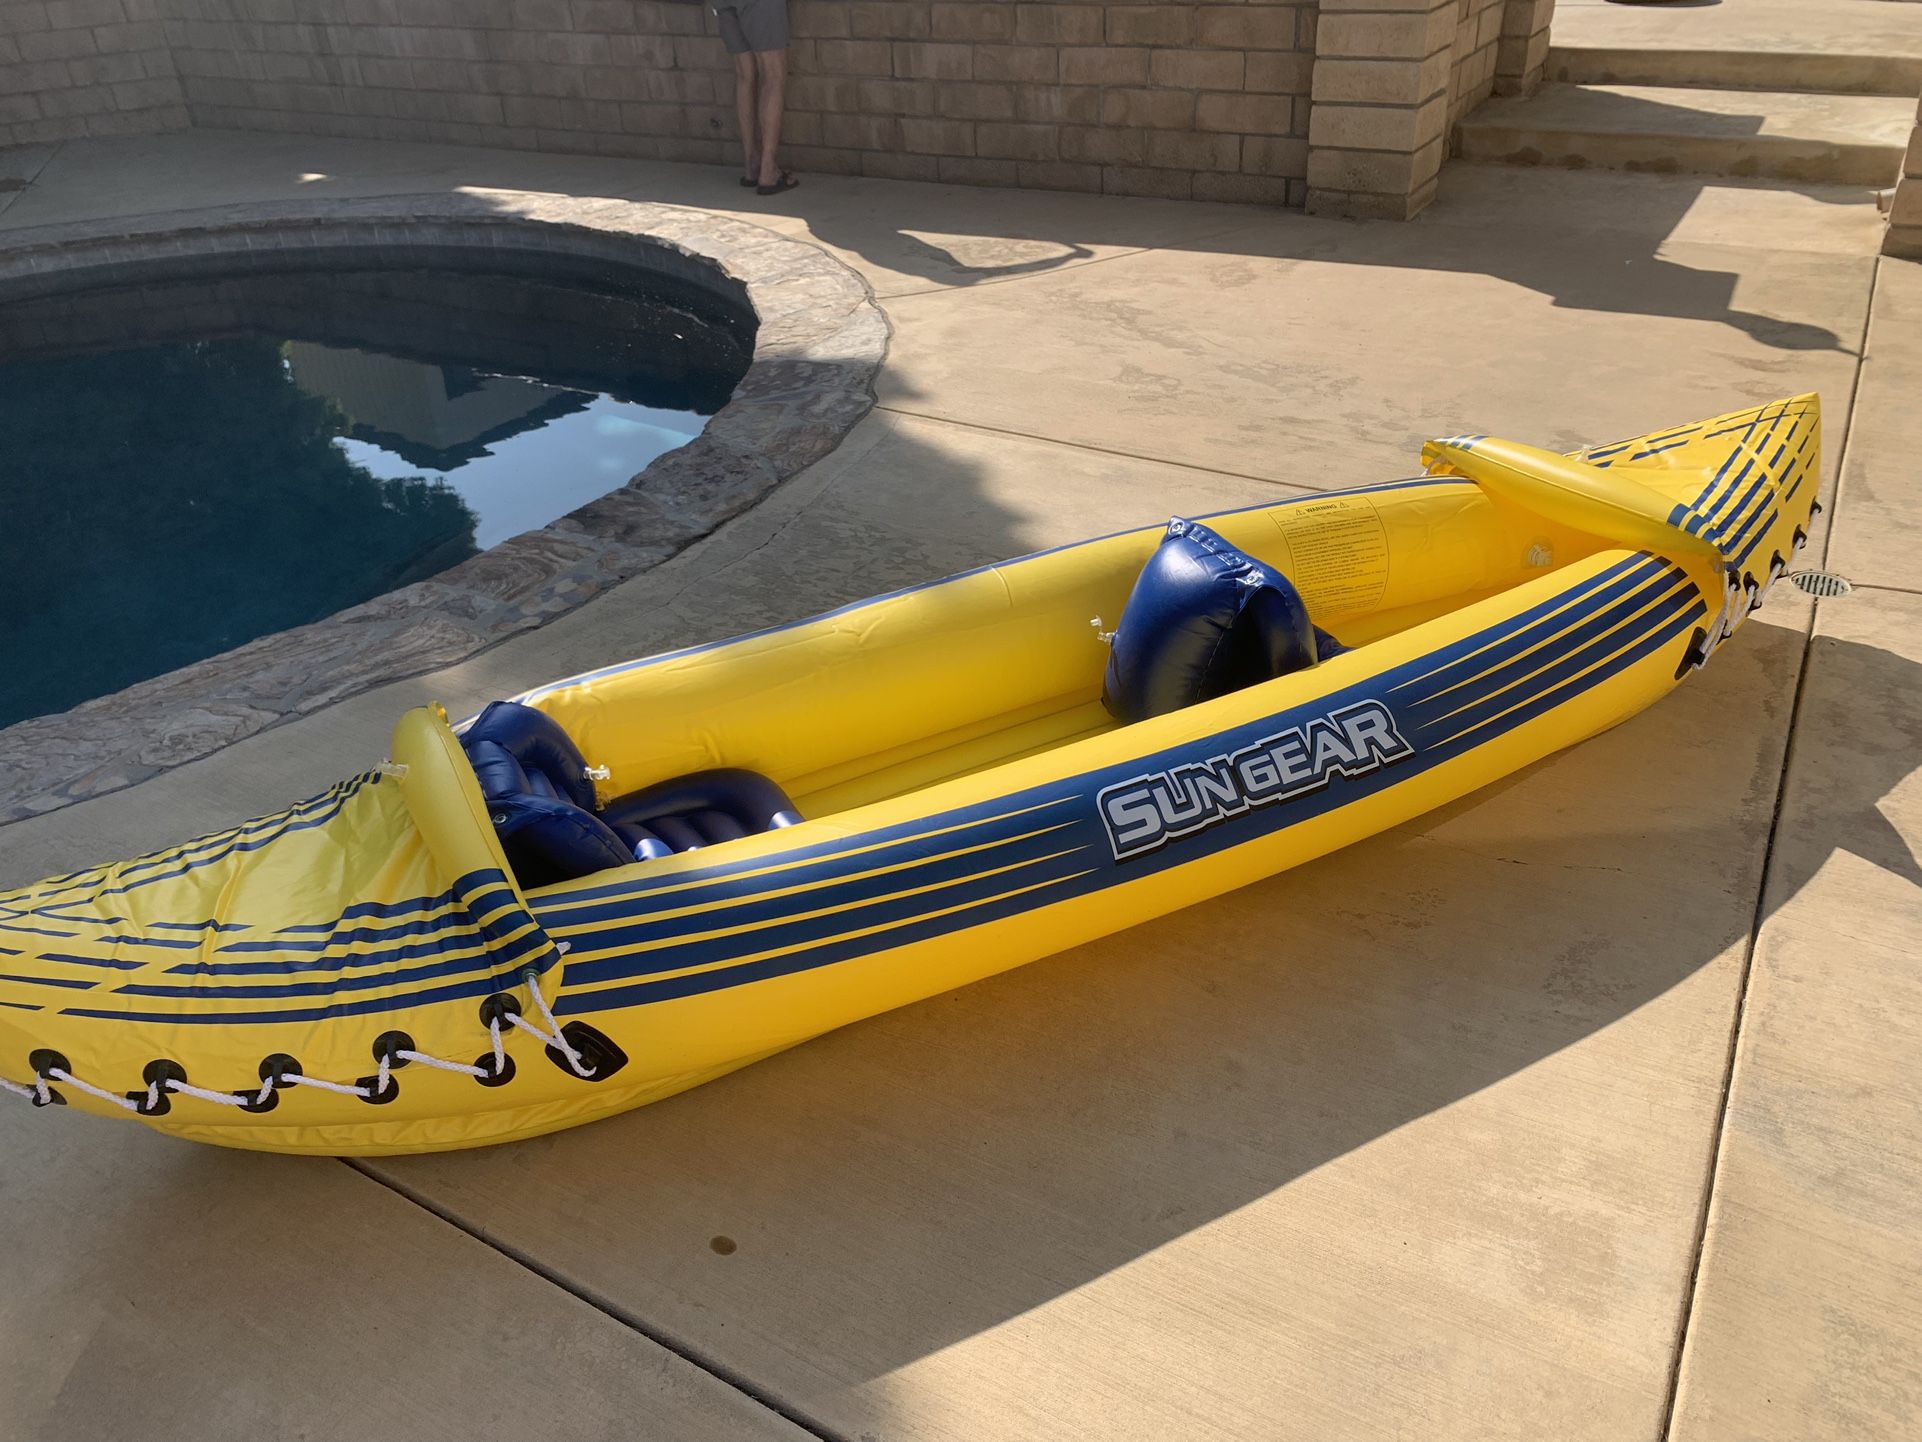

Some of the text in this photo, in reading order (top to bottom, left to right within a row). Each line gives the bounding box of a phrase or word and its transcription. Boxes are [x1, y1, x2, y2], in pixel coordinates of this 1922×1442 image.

[1305, 503, 1338, 514] WARNING
[1105, 707, 1400, 845] SUN GEAR
